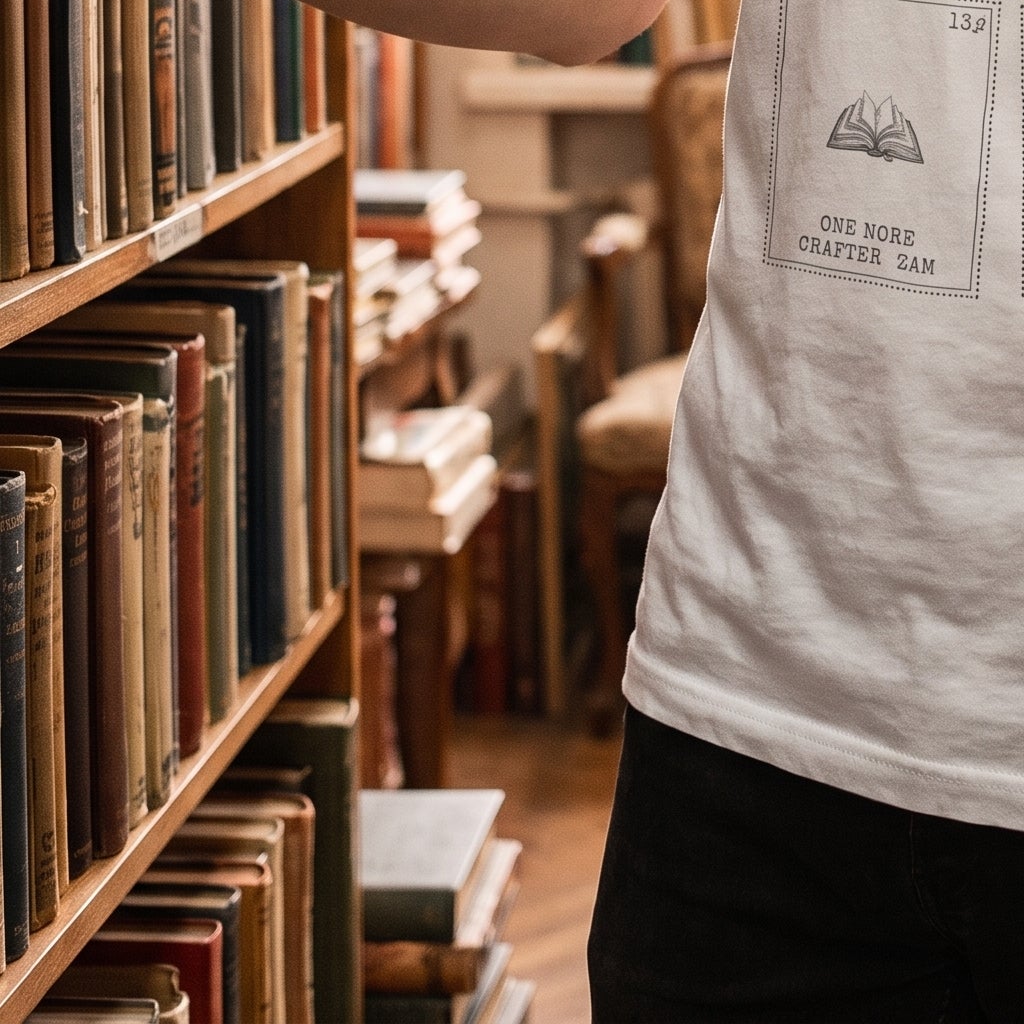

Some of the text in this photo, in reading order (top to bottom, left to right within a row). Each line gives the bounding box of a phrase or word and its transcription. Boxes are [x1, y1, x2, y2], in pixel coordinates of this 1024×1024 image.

[820, 214, 915, 247] ONE NORE
[798, 235, 882, 266] CRAFTER
